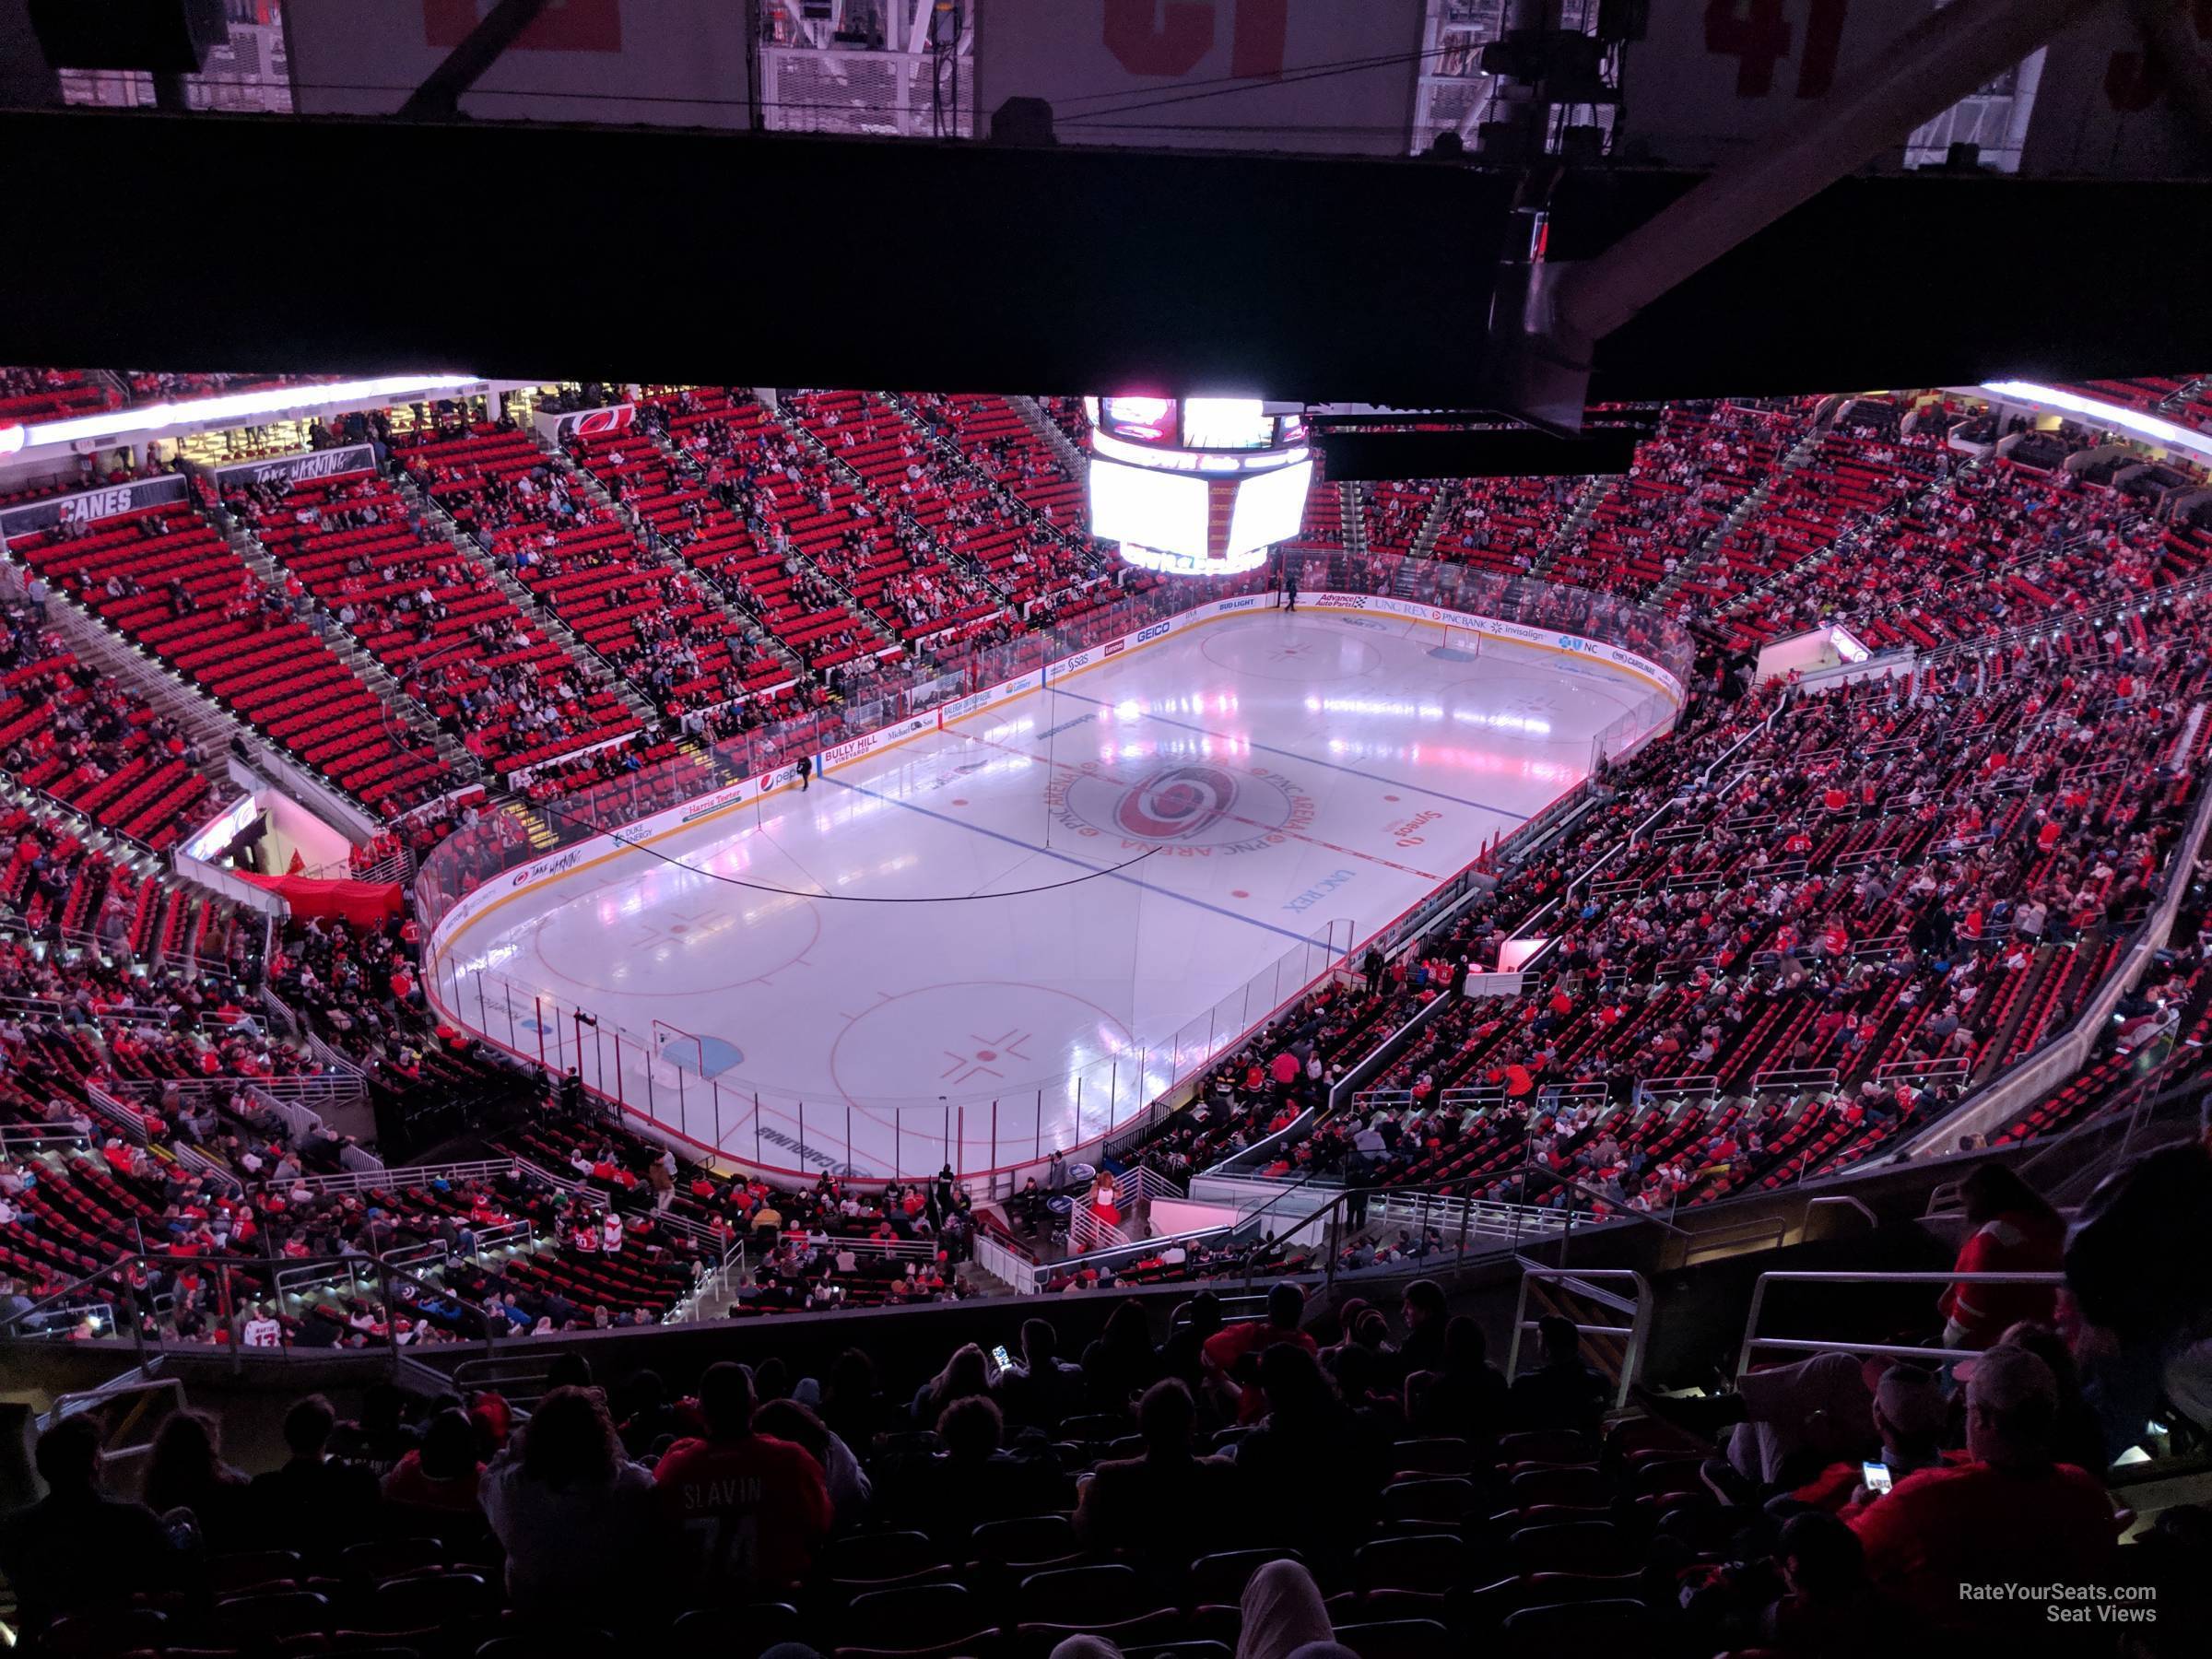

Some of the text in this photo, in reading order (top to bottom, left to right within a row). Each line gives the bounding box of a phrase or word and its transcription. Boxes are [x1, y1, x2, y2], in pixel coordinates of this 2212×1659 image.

[253, 452, 348, 485] TAKE WARNING
[59, 488, 132, 524] CANES
[1219, 598, 1254, 610] BUD LIGHT
[1321, 594, 1354, 603] Advance
[1374, 599, 1430, 618] UNC REX
[1442, 612, 1487, 629] PNC BANK
[1137, 621, 1171, 642] GEICO
[1505, 625, 1544, 641] invisalign
[1105, 641, 1124, 654] Lenovo
[1584, 642, 1598, 654] NC
[1627, 657, 1656, 676] CAROLINAS
[888, 725, 911, 740] Michael
[825, 735, 878, 762] BULLY HILL
[834, 747, 870, 765] VINEYARDS
[688, 799, 715, 815] Harris
[715, 789, 741, 804] Teeter
[1266, 772, 1315, 830] PNC ARENA
[626, 823, 644, 837] DUKE
[627, 829, 653, 845] ENERGY
[1120, 839, 1272, 857] PNC ARENA
[529, 850, 582, 878] TAKE WARNING
[1281, 869, 1357, 913] UNC REX
[684, 1476, 762, 1510] SLAVIN
